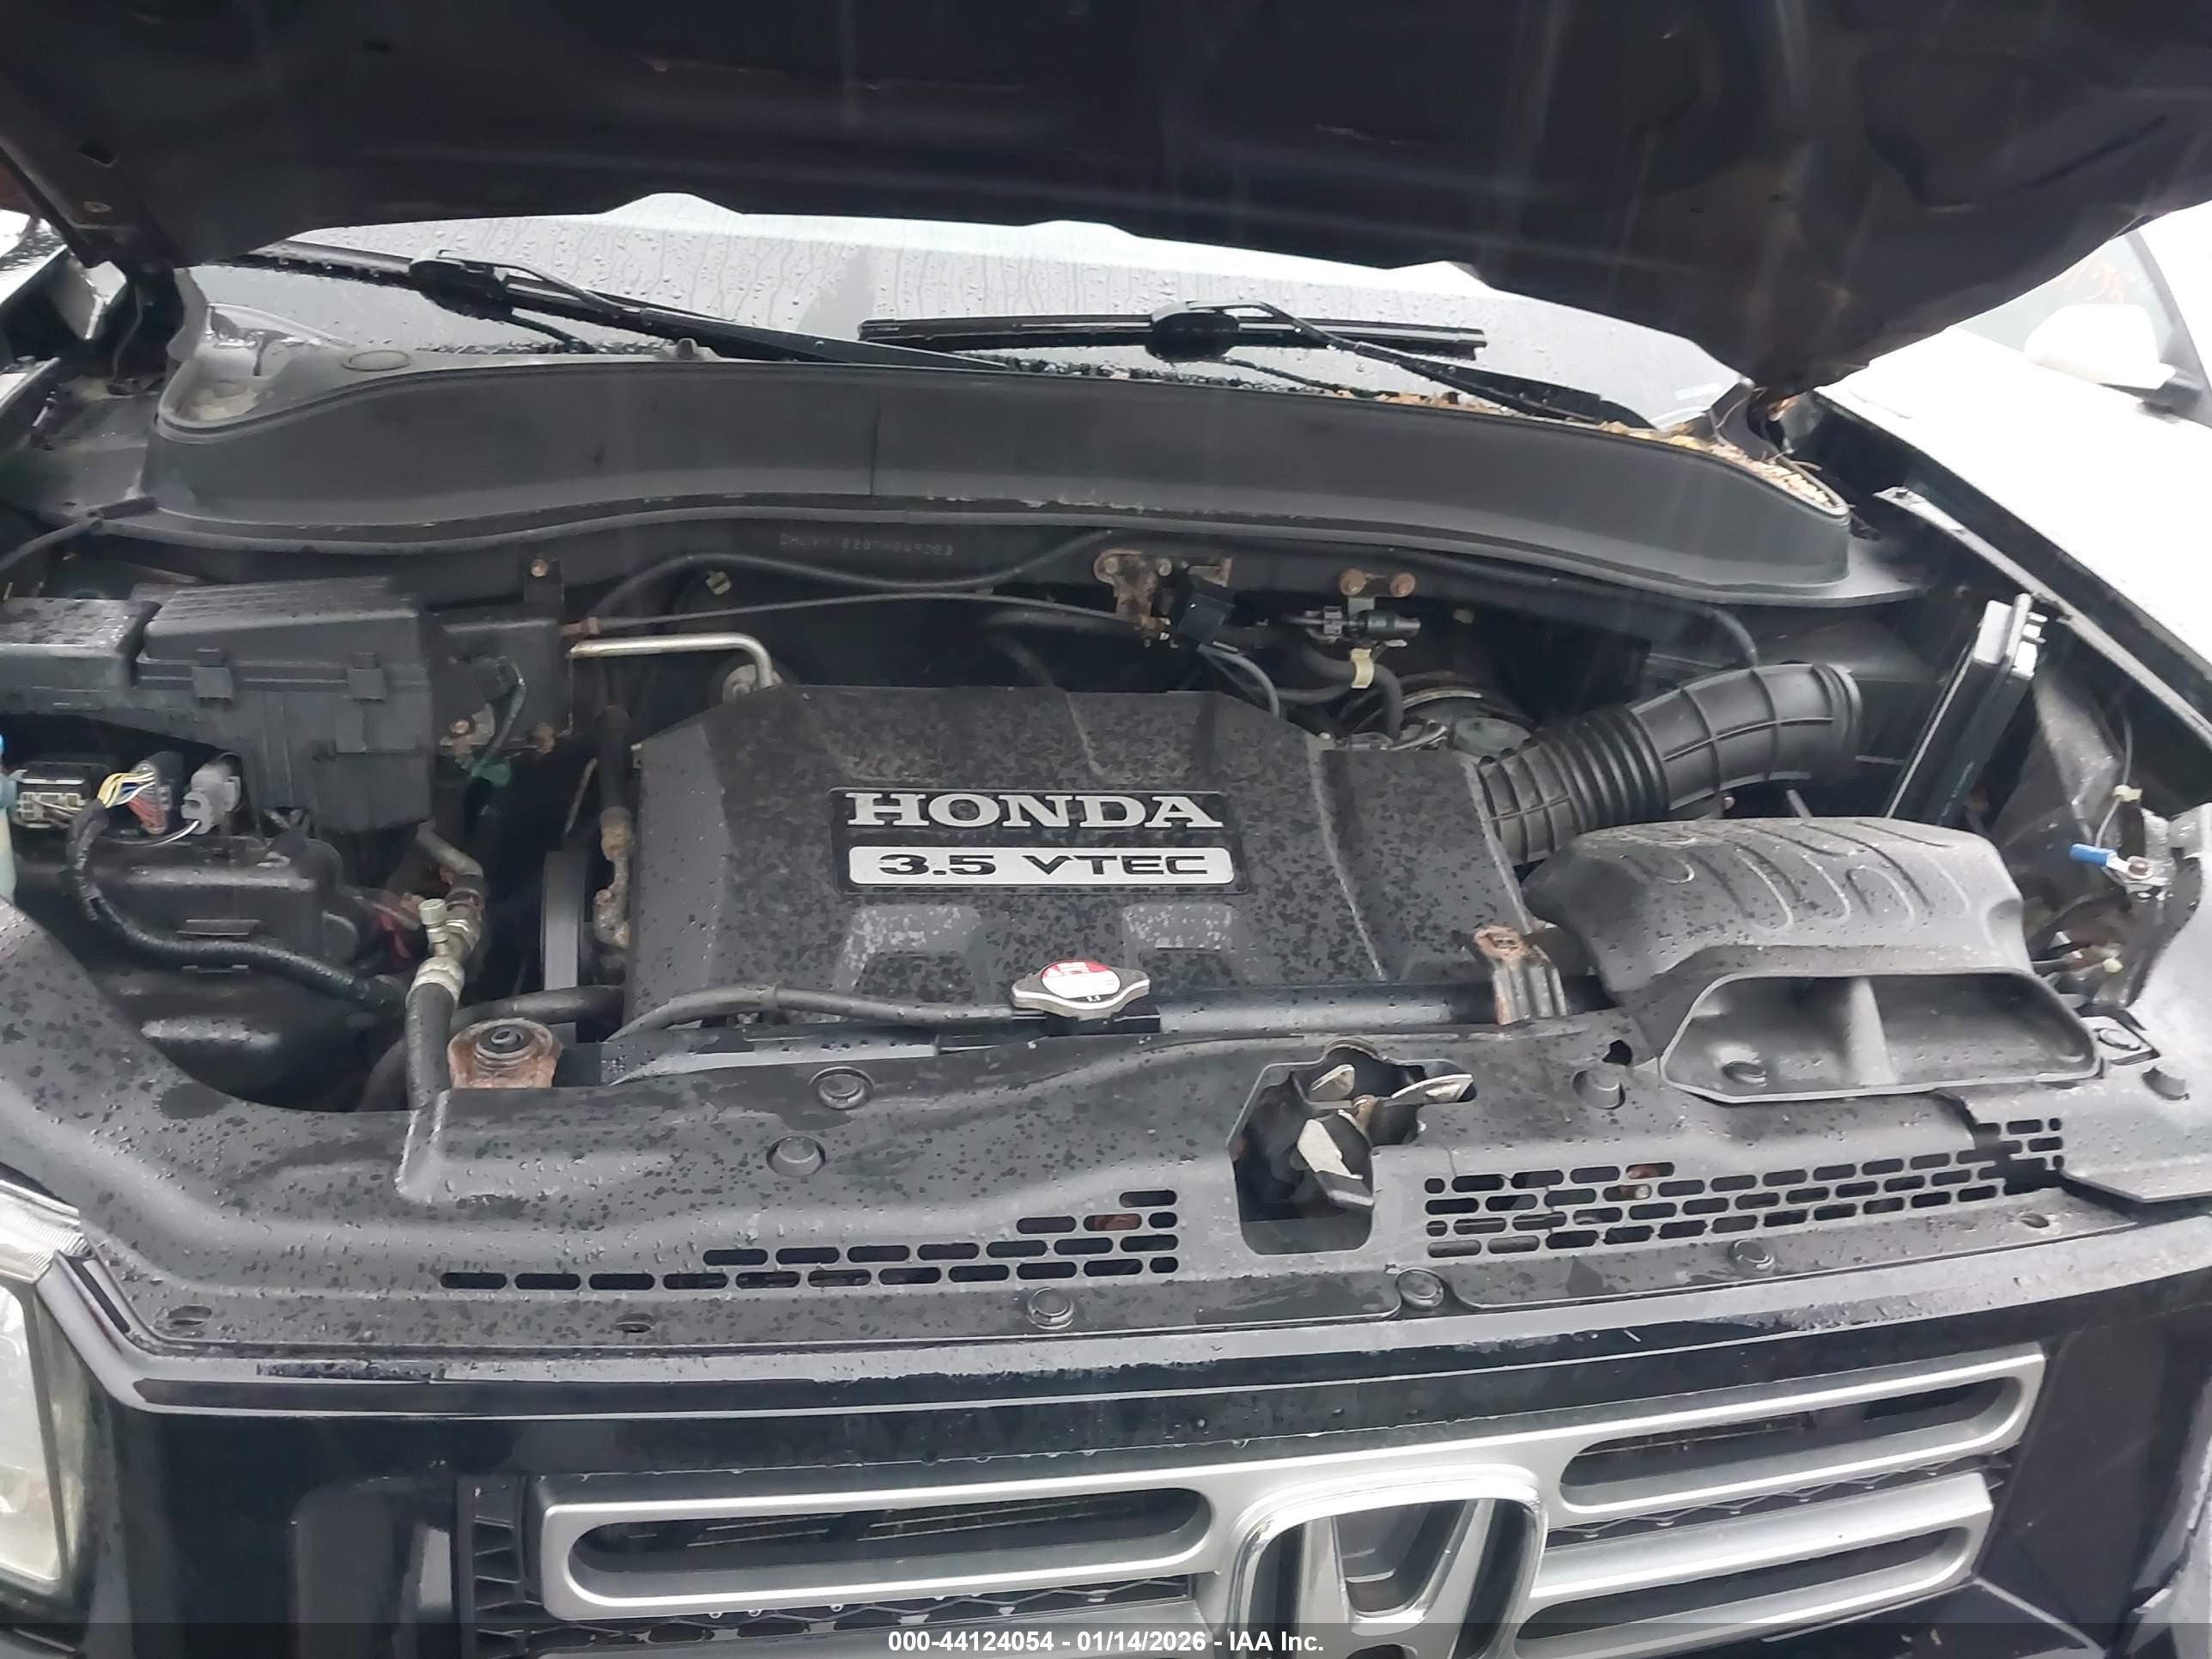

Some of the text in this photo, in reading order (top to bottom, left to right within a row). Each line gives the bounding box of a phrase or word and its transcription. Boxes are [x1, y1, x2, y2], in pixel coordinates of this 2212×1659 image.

[845, 792, 1223, 828] HONDA
[878, 854, 1209, 876] 3.5 VTEC
